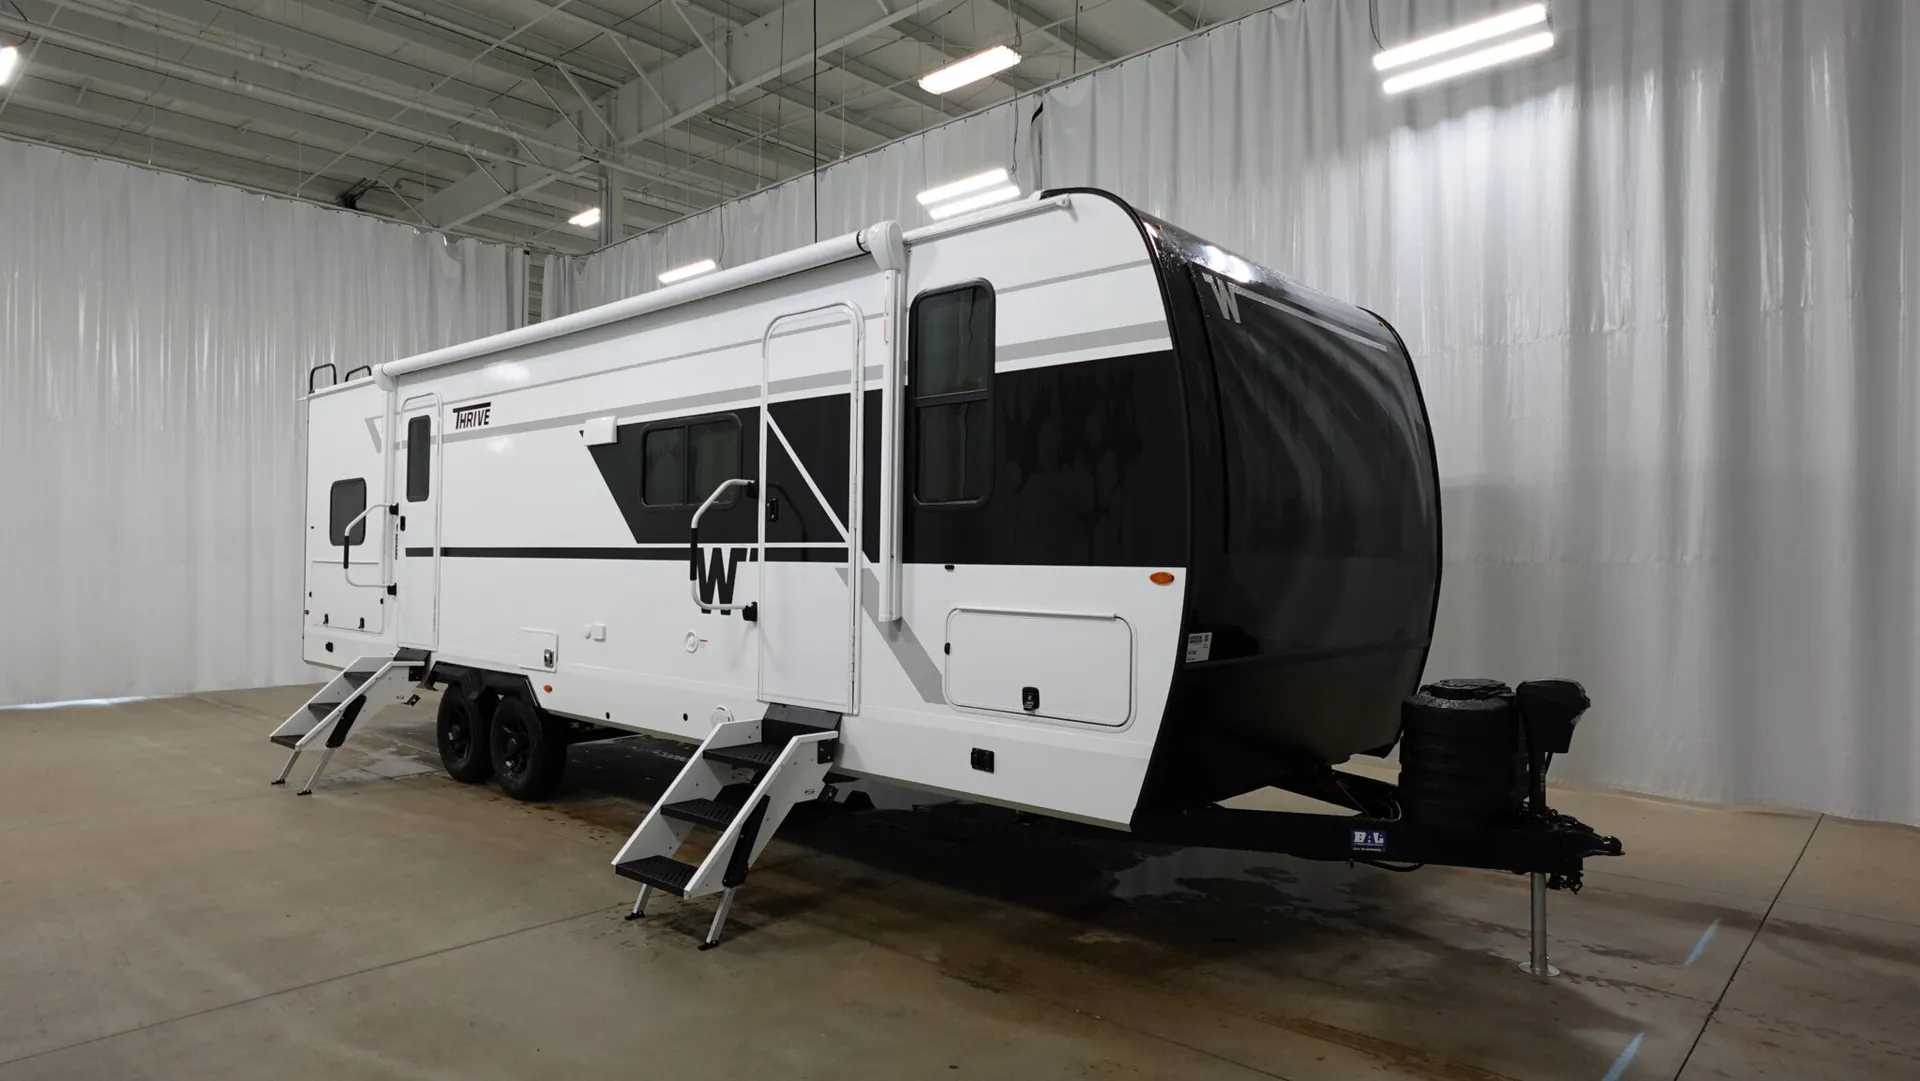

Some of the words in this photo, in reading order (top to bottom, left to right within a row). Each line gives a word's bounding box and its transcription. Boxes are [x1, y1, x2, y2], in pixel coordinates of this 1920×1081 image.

[1202, 272, 1242, 324] W
[453, 402, 491, 430] THRIVE
[696, 547, 748, 616] W
